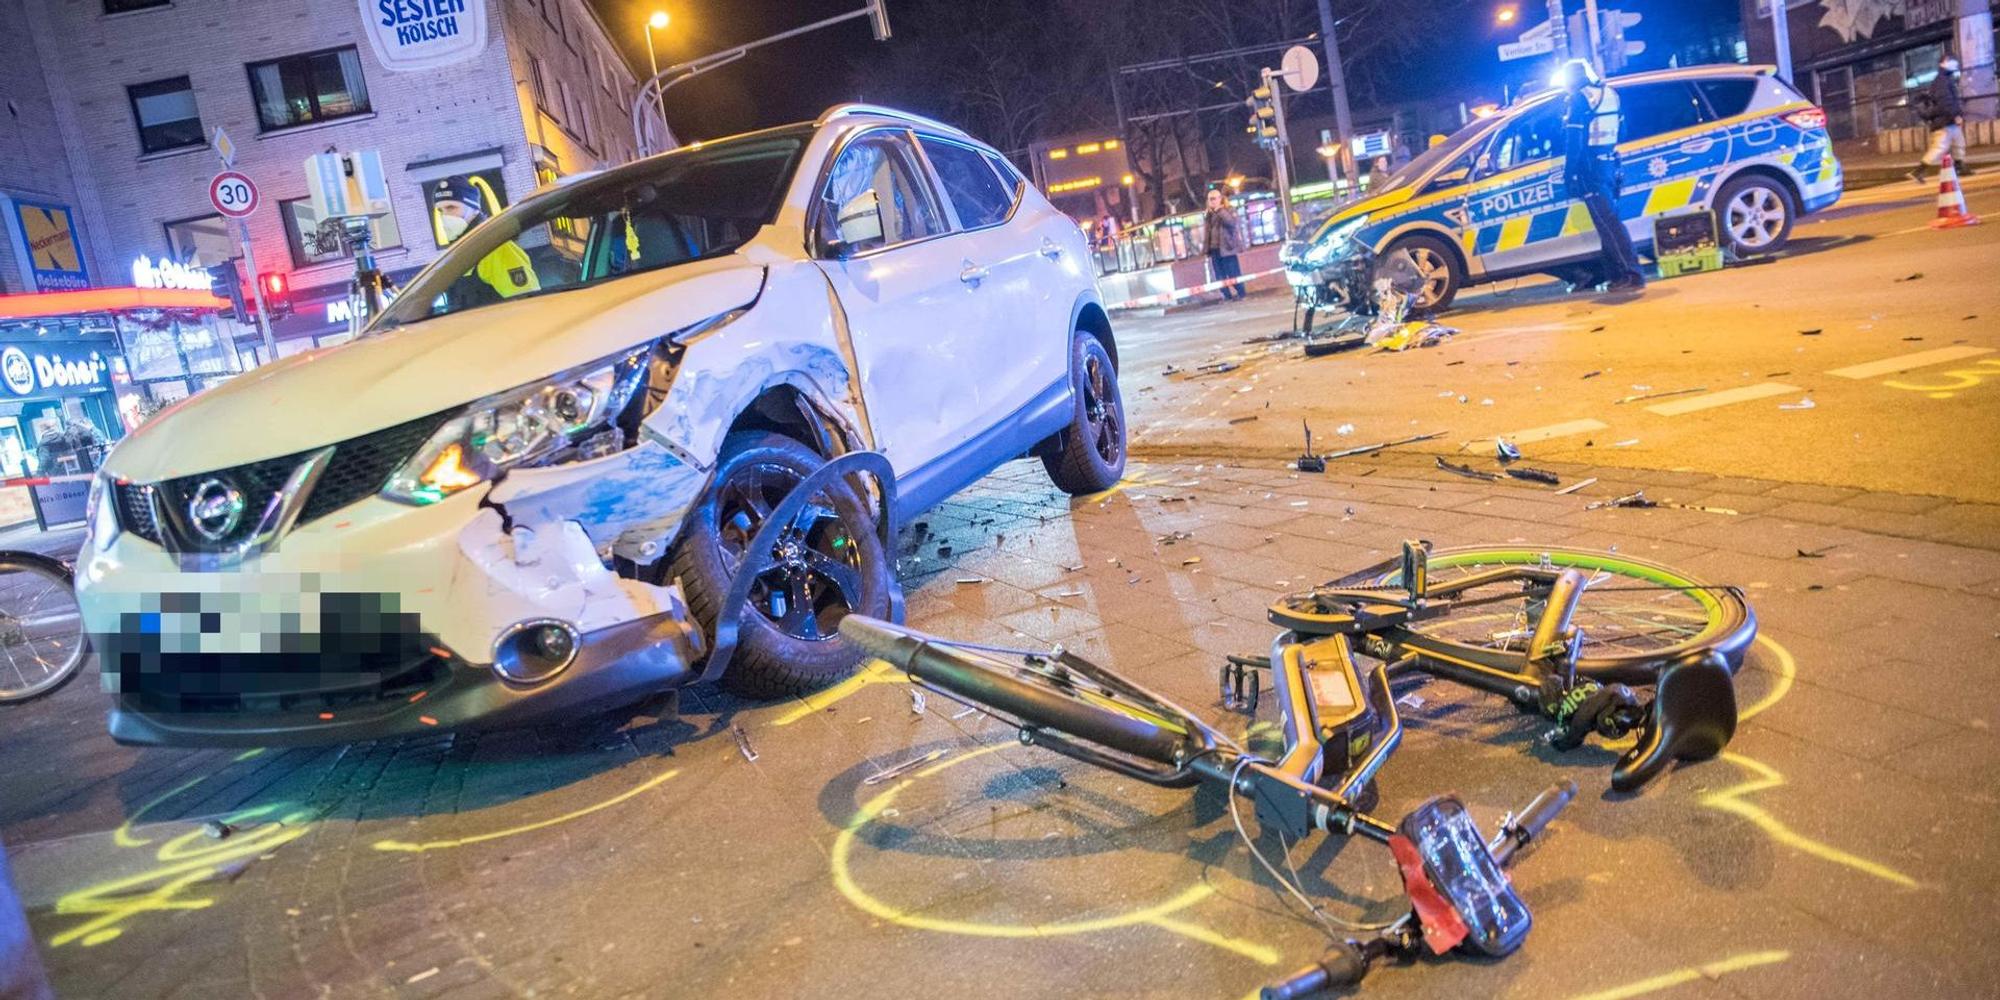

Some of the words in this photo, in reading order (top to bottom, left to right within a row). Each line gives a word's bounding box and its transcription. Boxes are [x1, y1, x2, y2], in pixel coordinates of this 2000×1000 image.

[396, 16, 459, 46] KÖLSCH
[220, 184, 249, 204] 30
[1482, 183, 1554, 216] POLIZEI
[35, 352, 100, 388] Döner
